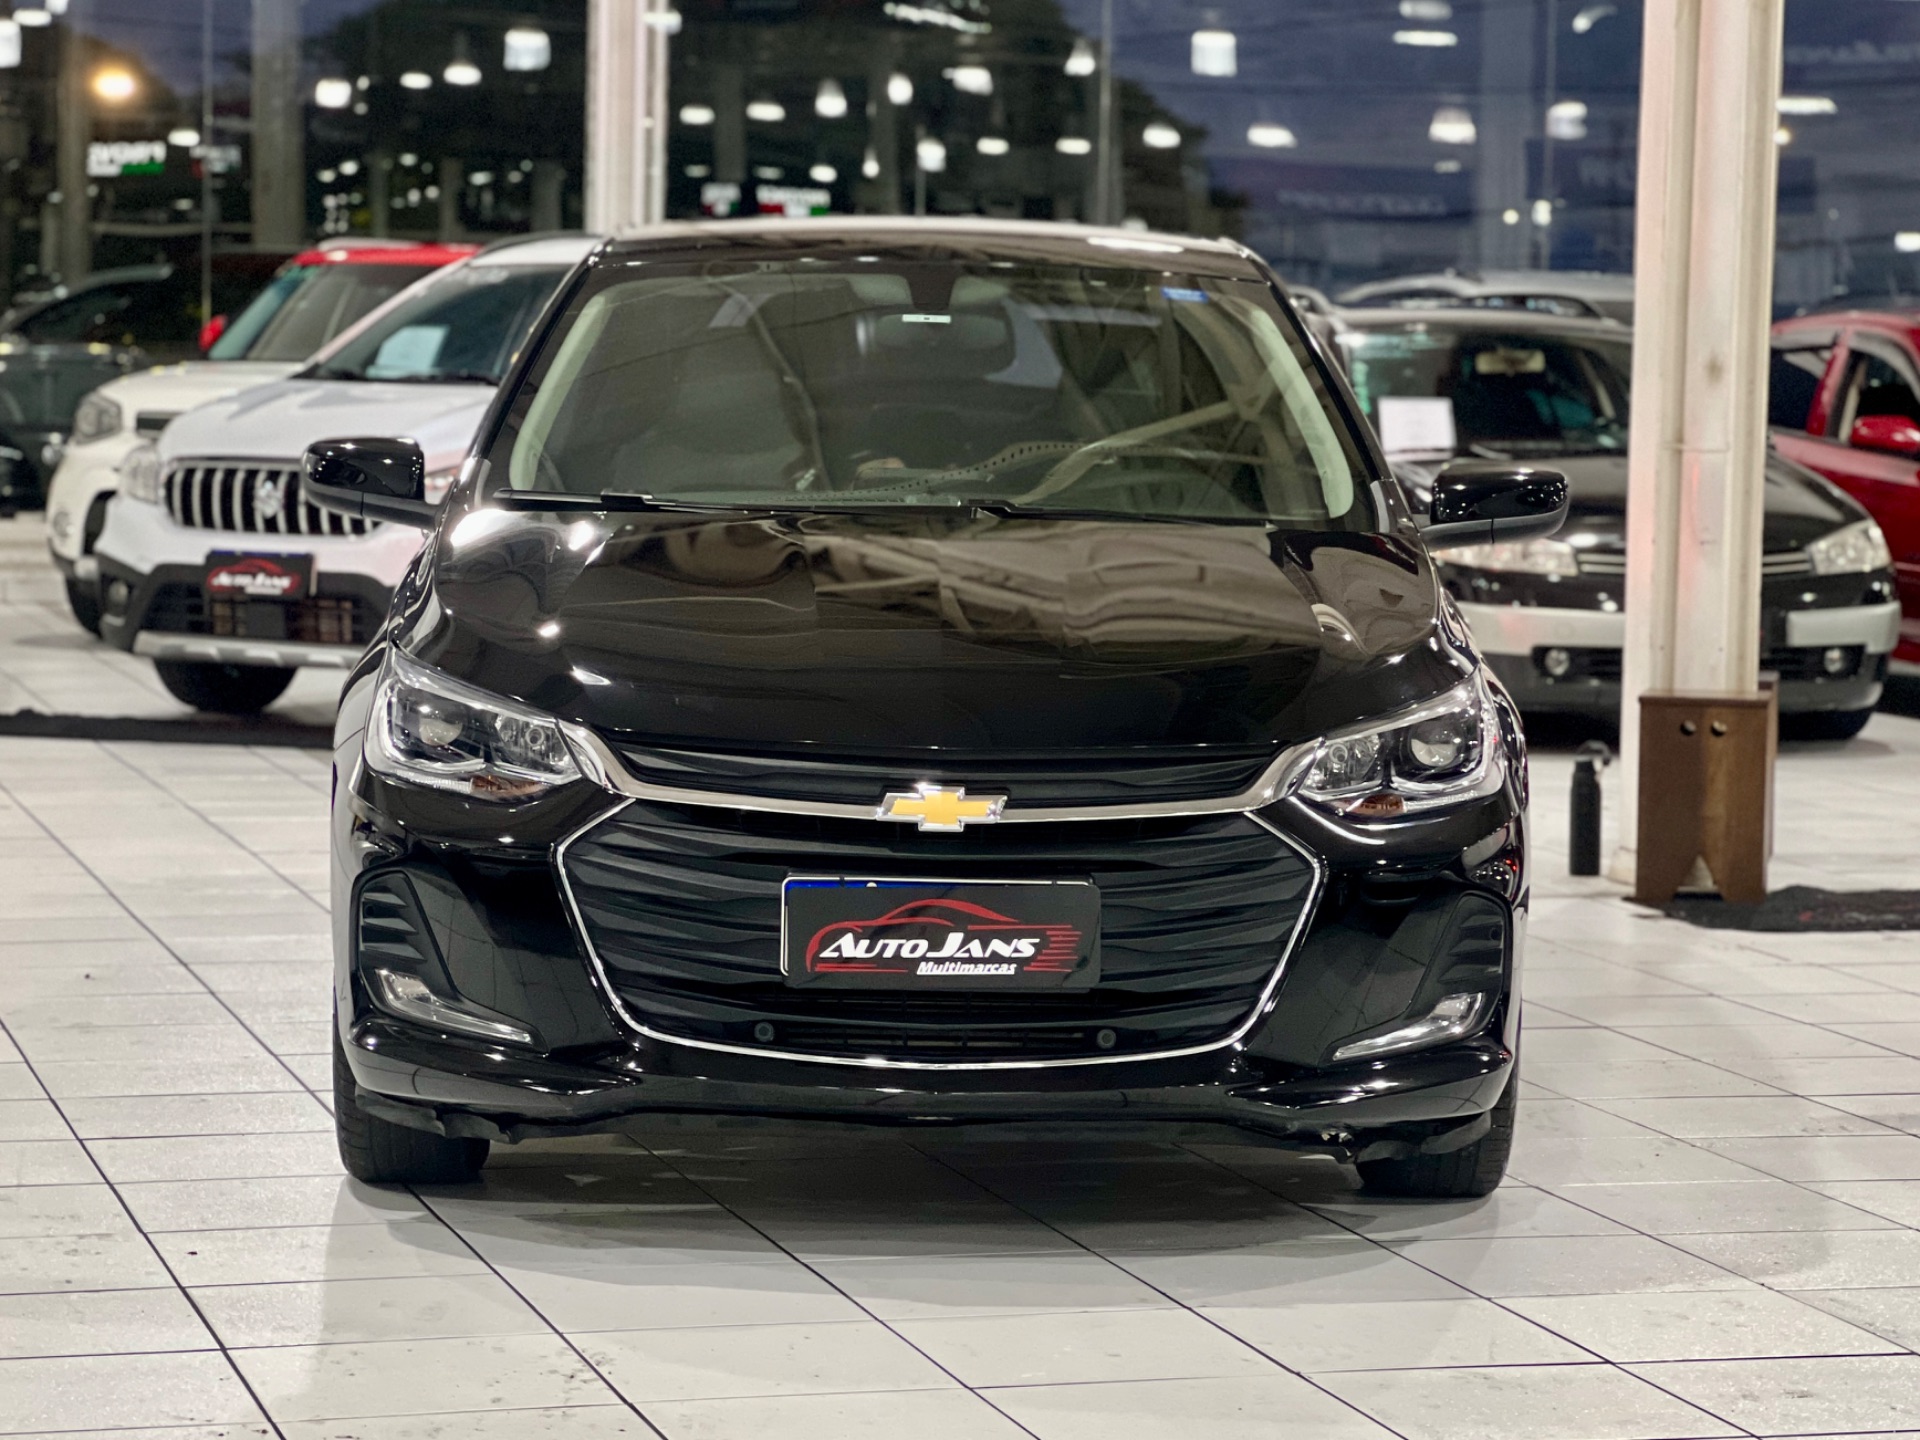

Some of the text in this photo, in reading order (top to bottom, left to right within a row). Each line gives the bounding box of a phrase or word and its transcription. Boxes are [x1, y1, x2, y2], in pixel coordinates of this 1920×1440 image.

[819, 932, 1040, 958] AUTO JANS
[916, 961, 1017, 975] Multimarcas
